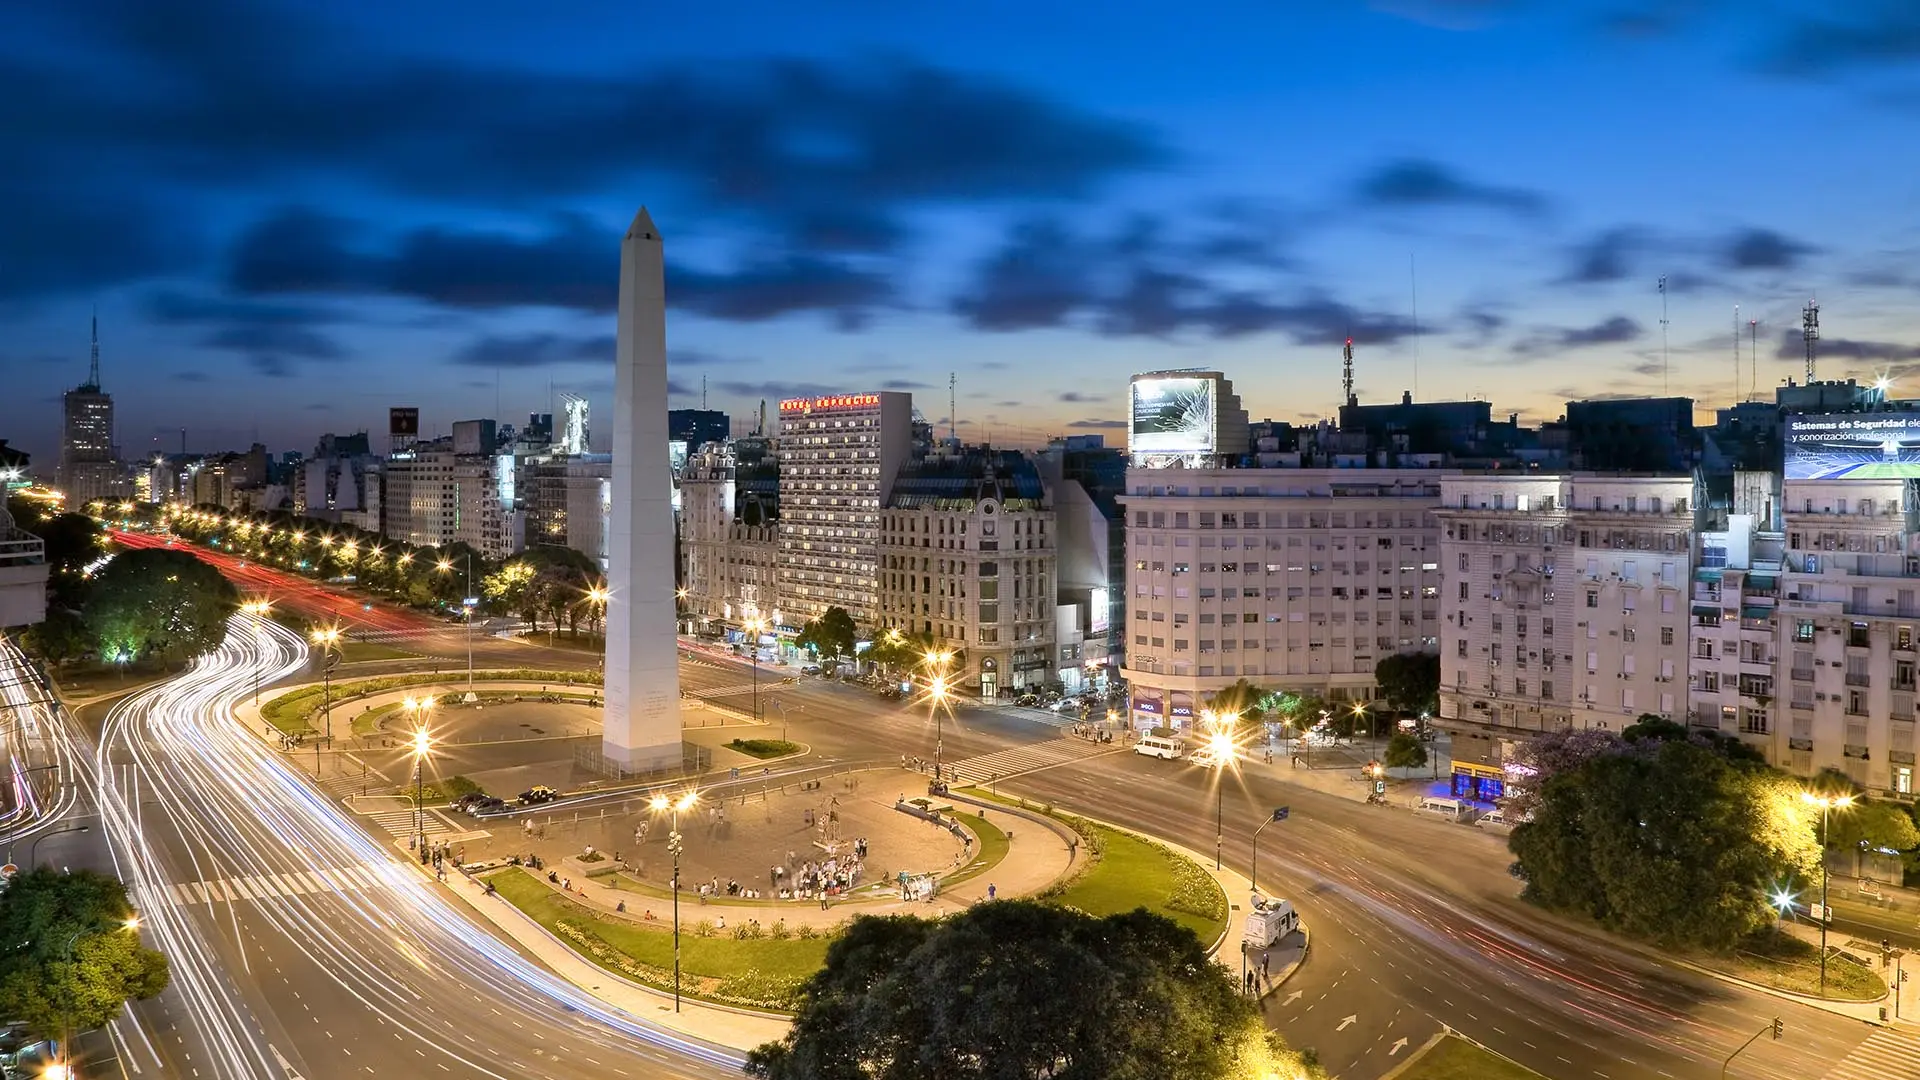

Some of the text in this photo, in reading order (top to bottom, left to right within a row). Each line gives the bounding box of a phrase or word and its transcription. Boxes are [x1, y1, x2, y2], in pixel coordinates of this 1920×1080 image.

[780, 401, 811, 410] HOTEL
[1792, 422, 1836, 430] Sistemas
[1839, 421, 1851, 429] de
[1854, 419, 1906, 430] Seguridad
[1792, 431, 1906, 443] y sonorización profesional
